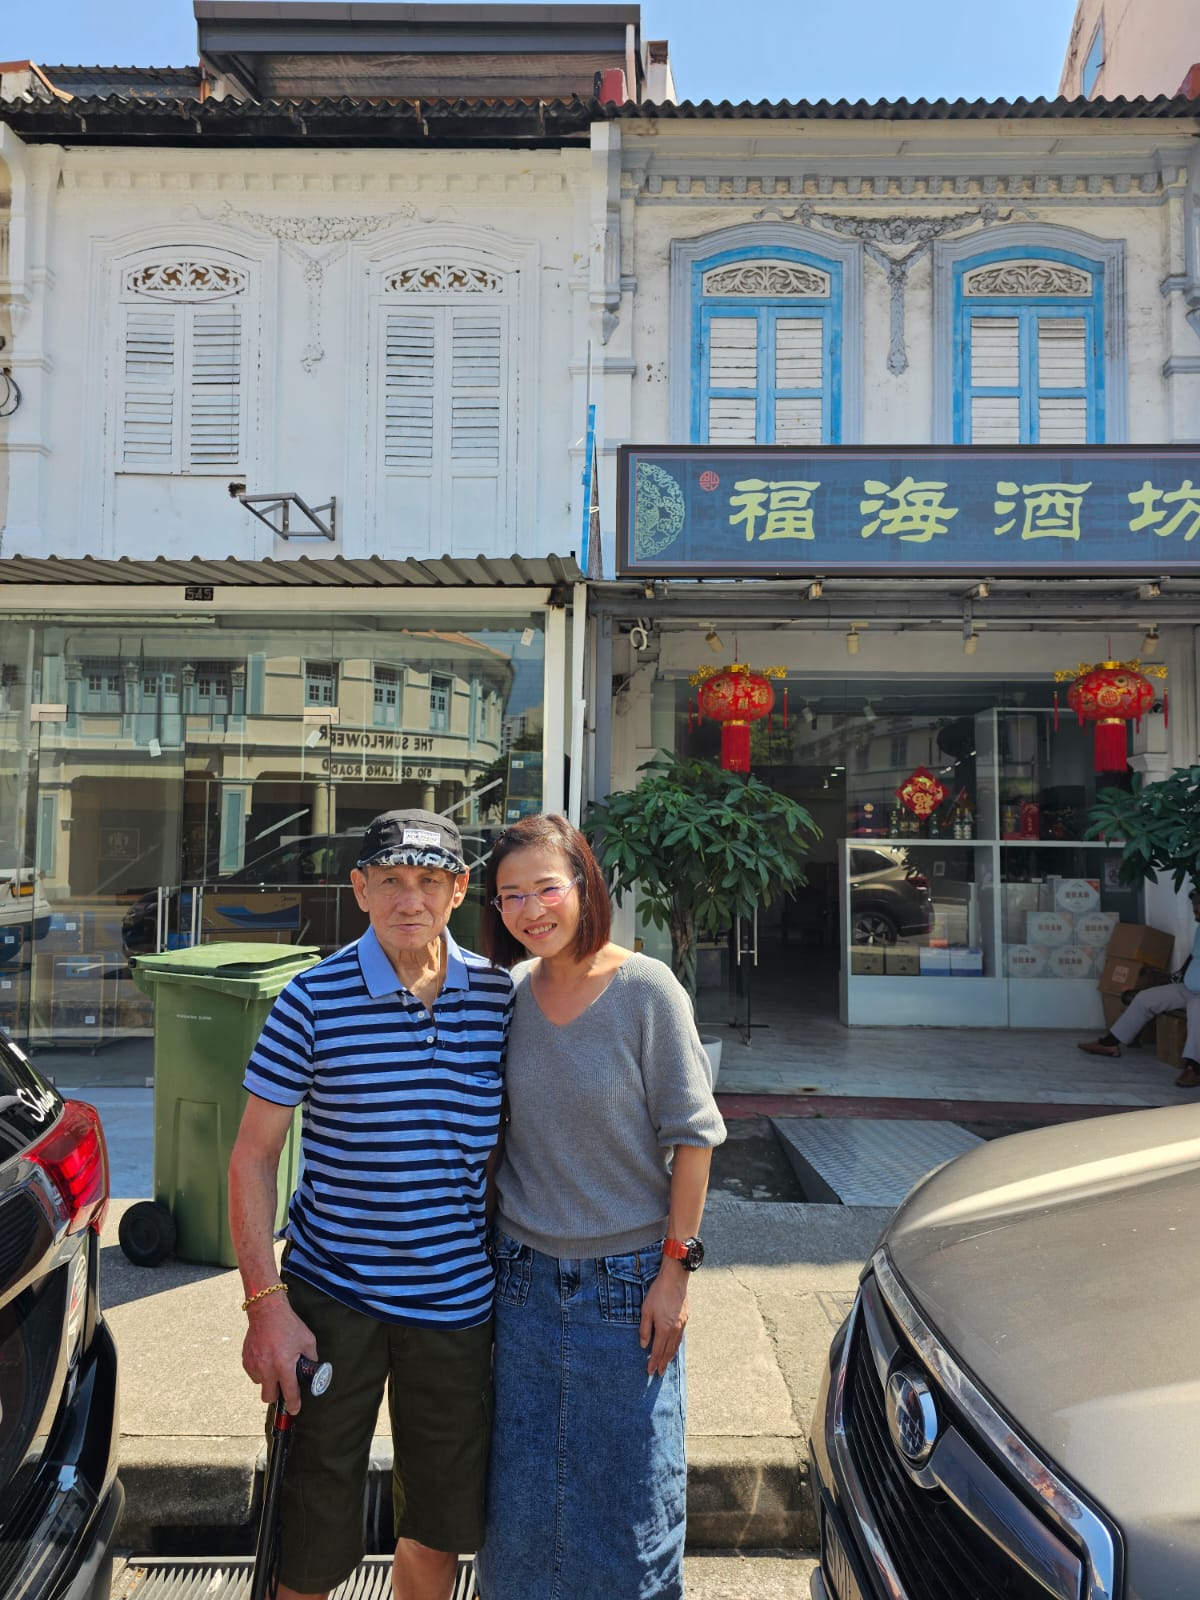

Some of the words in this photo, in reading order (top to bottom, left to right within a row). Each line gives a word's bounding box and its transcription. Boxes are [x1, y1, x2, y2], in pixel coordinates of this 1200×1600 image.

[729, 476, 1200, 542] 福海酒坊
[186, 588, 213, 600] 545
